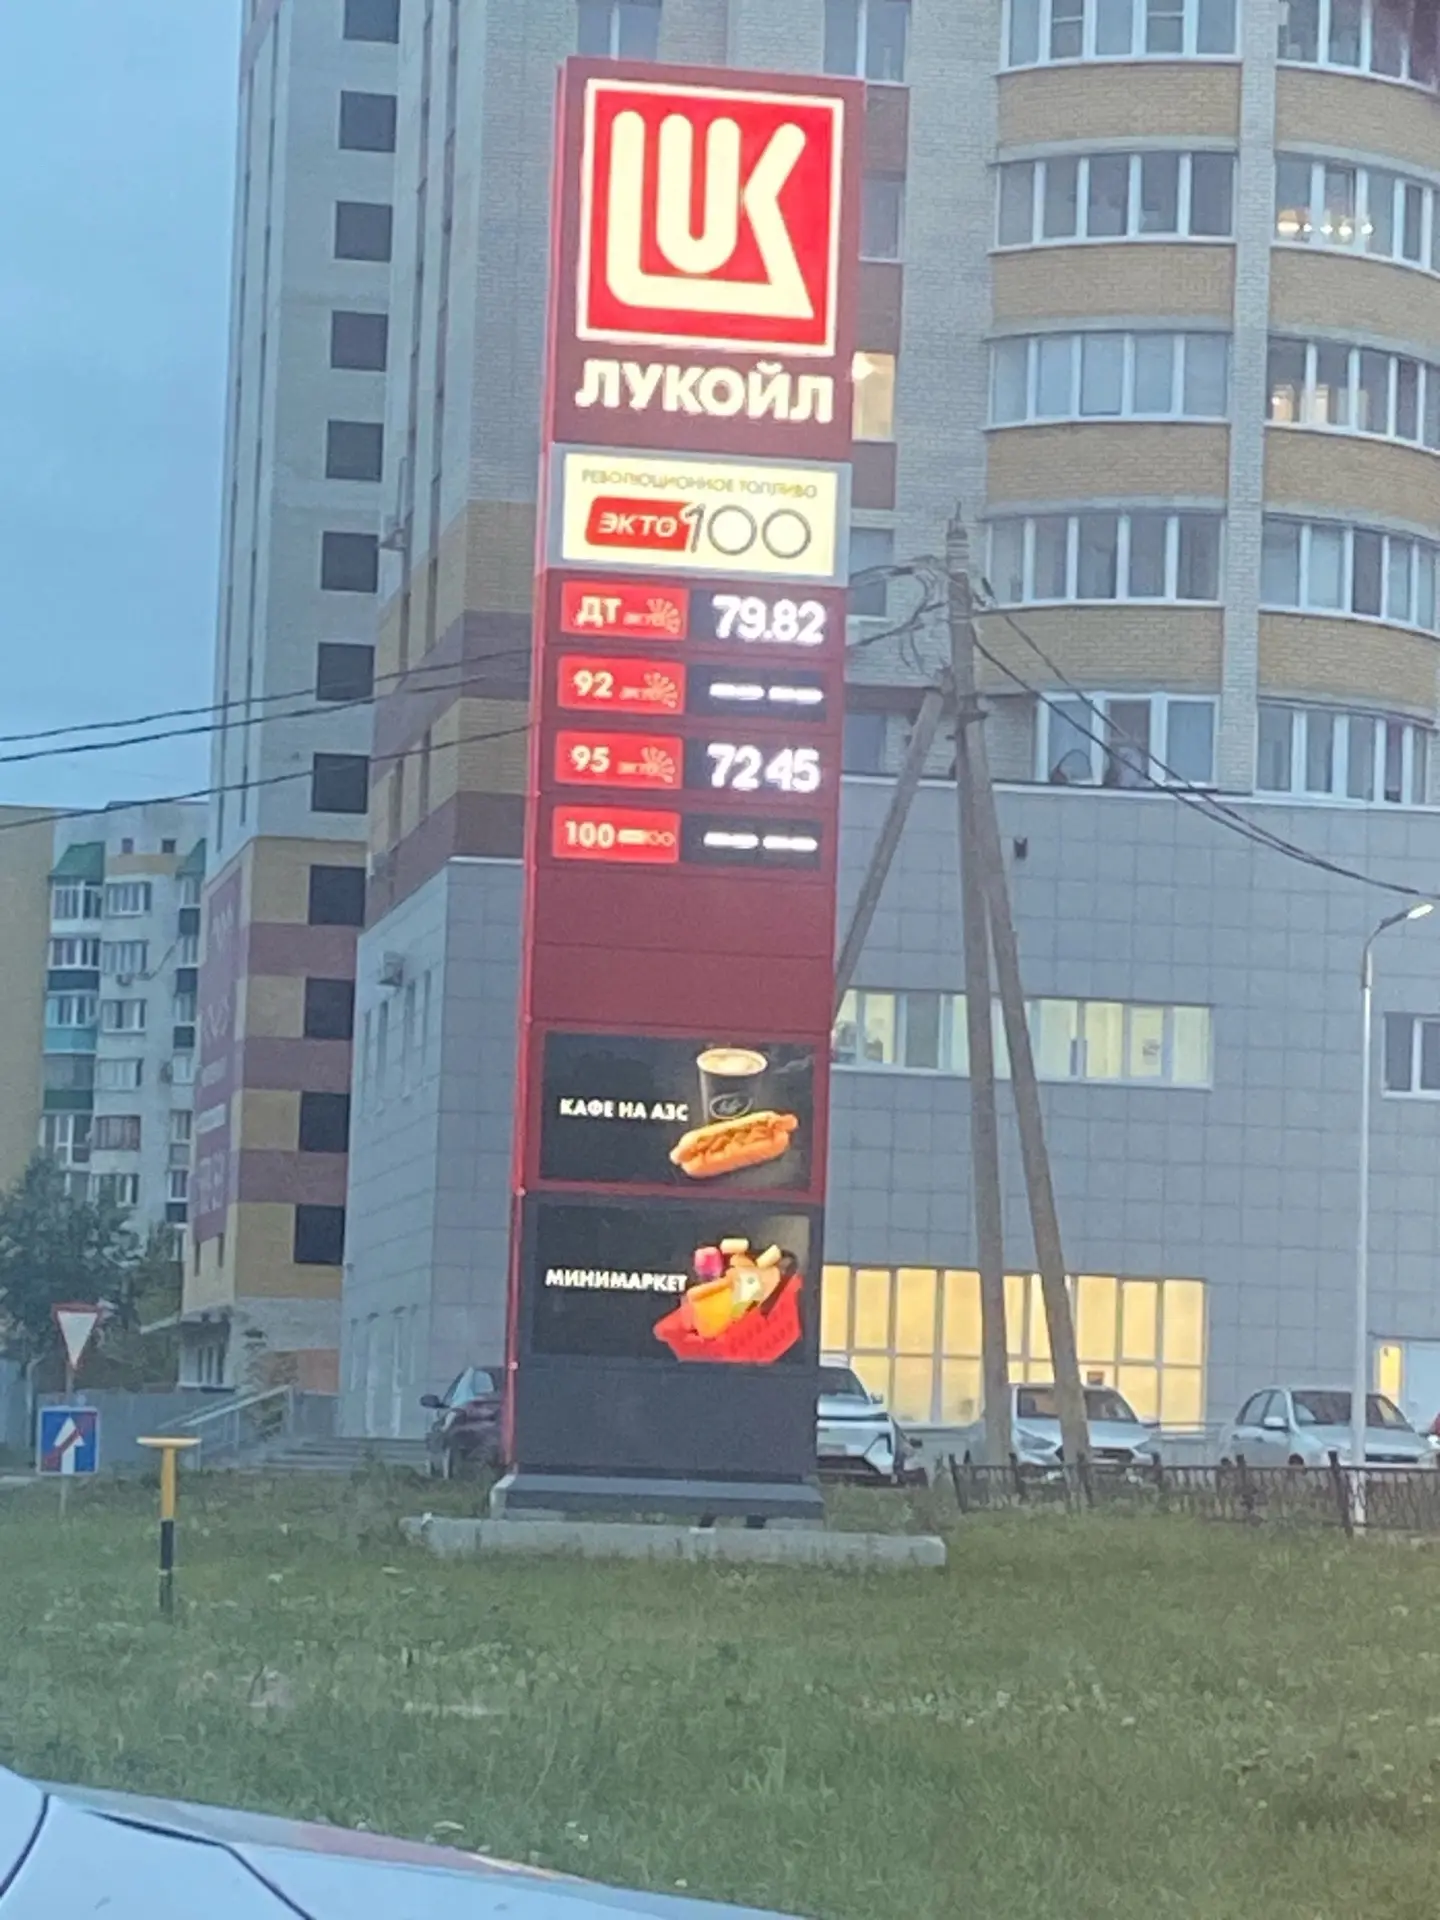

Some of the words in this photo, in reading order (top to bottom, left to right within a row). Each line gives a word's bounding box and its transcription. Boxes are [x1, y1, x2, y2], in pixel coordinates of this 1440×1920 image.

[575, 358, 834, 423] ЛУКОЙЛ
[581, 469, 735, 492] РЕВОЛЮЦИОННОЕ
[739, 480, 818, 498] ТОПЛИВО
[575, 597, 622, 628] ДТ
[712, 594, 827, 645] 79.82
[572, 670, 614, 699] 92
[570, 745, 611, 774] 95
[564, 820, 615, 848] 100
[559, 1099, 613, 1119] КАФЕ
[618, 1101, 647, 1119] НА
[651, 1103, 690, 1122] АЗС
[545, 1268, 688, 1293] МИНИМАРКЕТ
